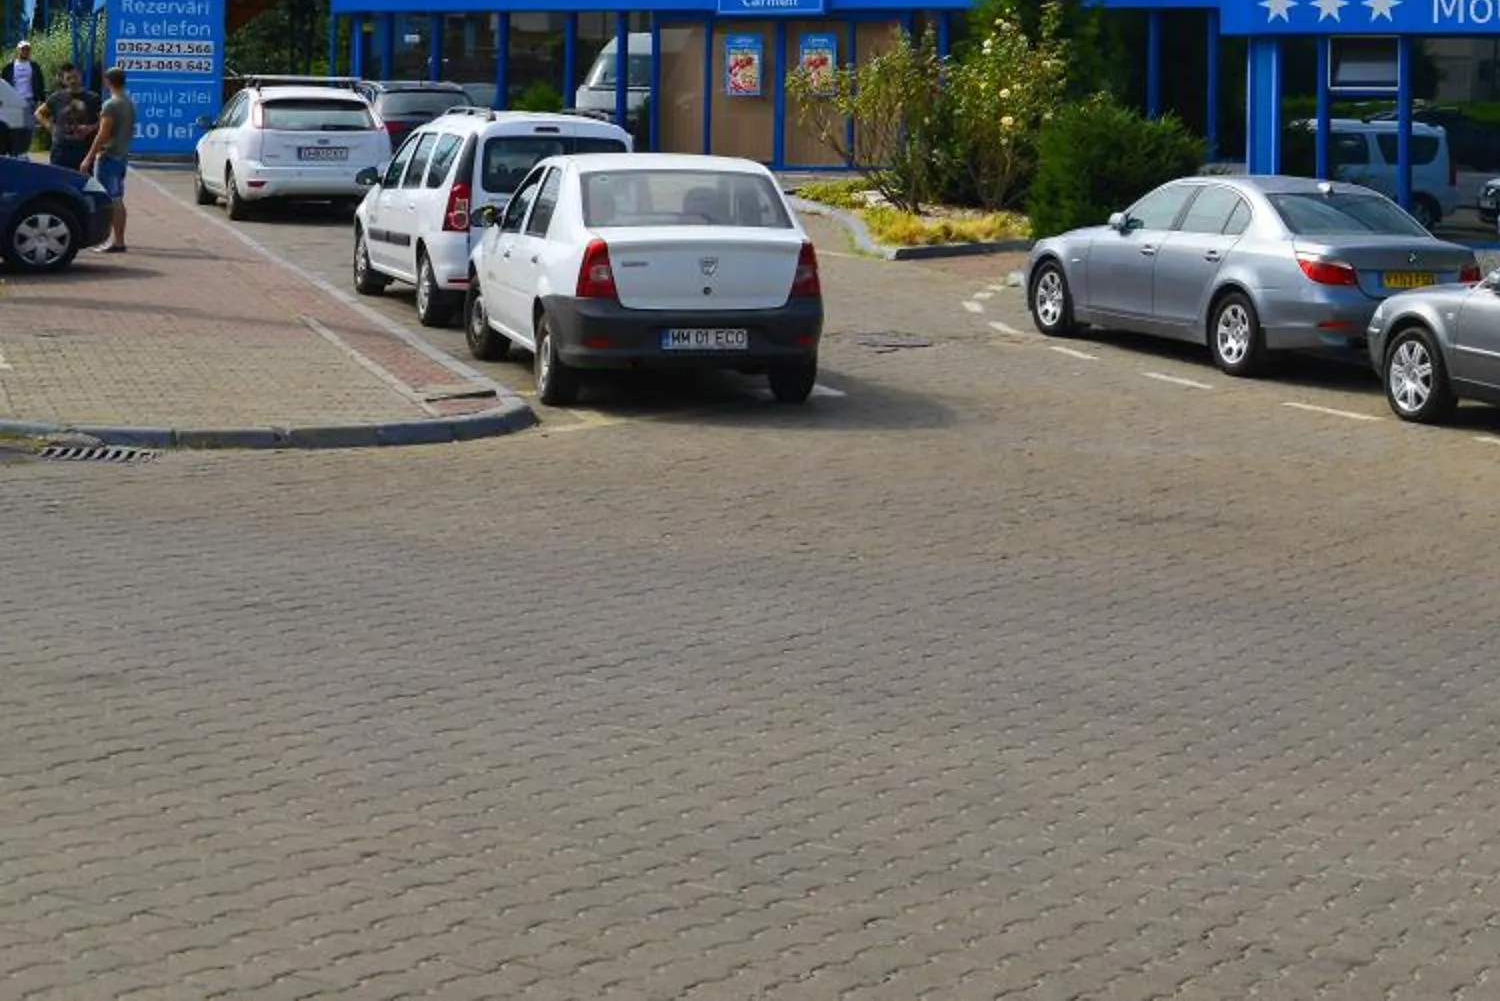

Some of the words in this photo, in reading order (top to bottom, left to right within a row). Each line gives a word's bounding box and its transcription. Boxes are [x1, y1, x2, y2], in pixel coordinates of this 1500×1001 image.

[120, 18, 137, 36] la
[143, 19, 211, 36] telefon
[128, 88, 173, 104] eniul
[145, 106, 165, 118] de
[169, 106, 183, 118] la
[132, 122, 160, 138] 10
[167, 122, 194, 138] lei
